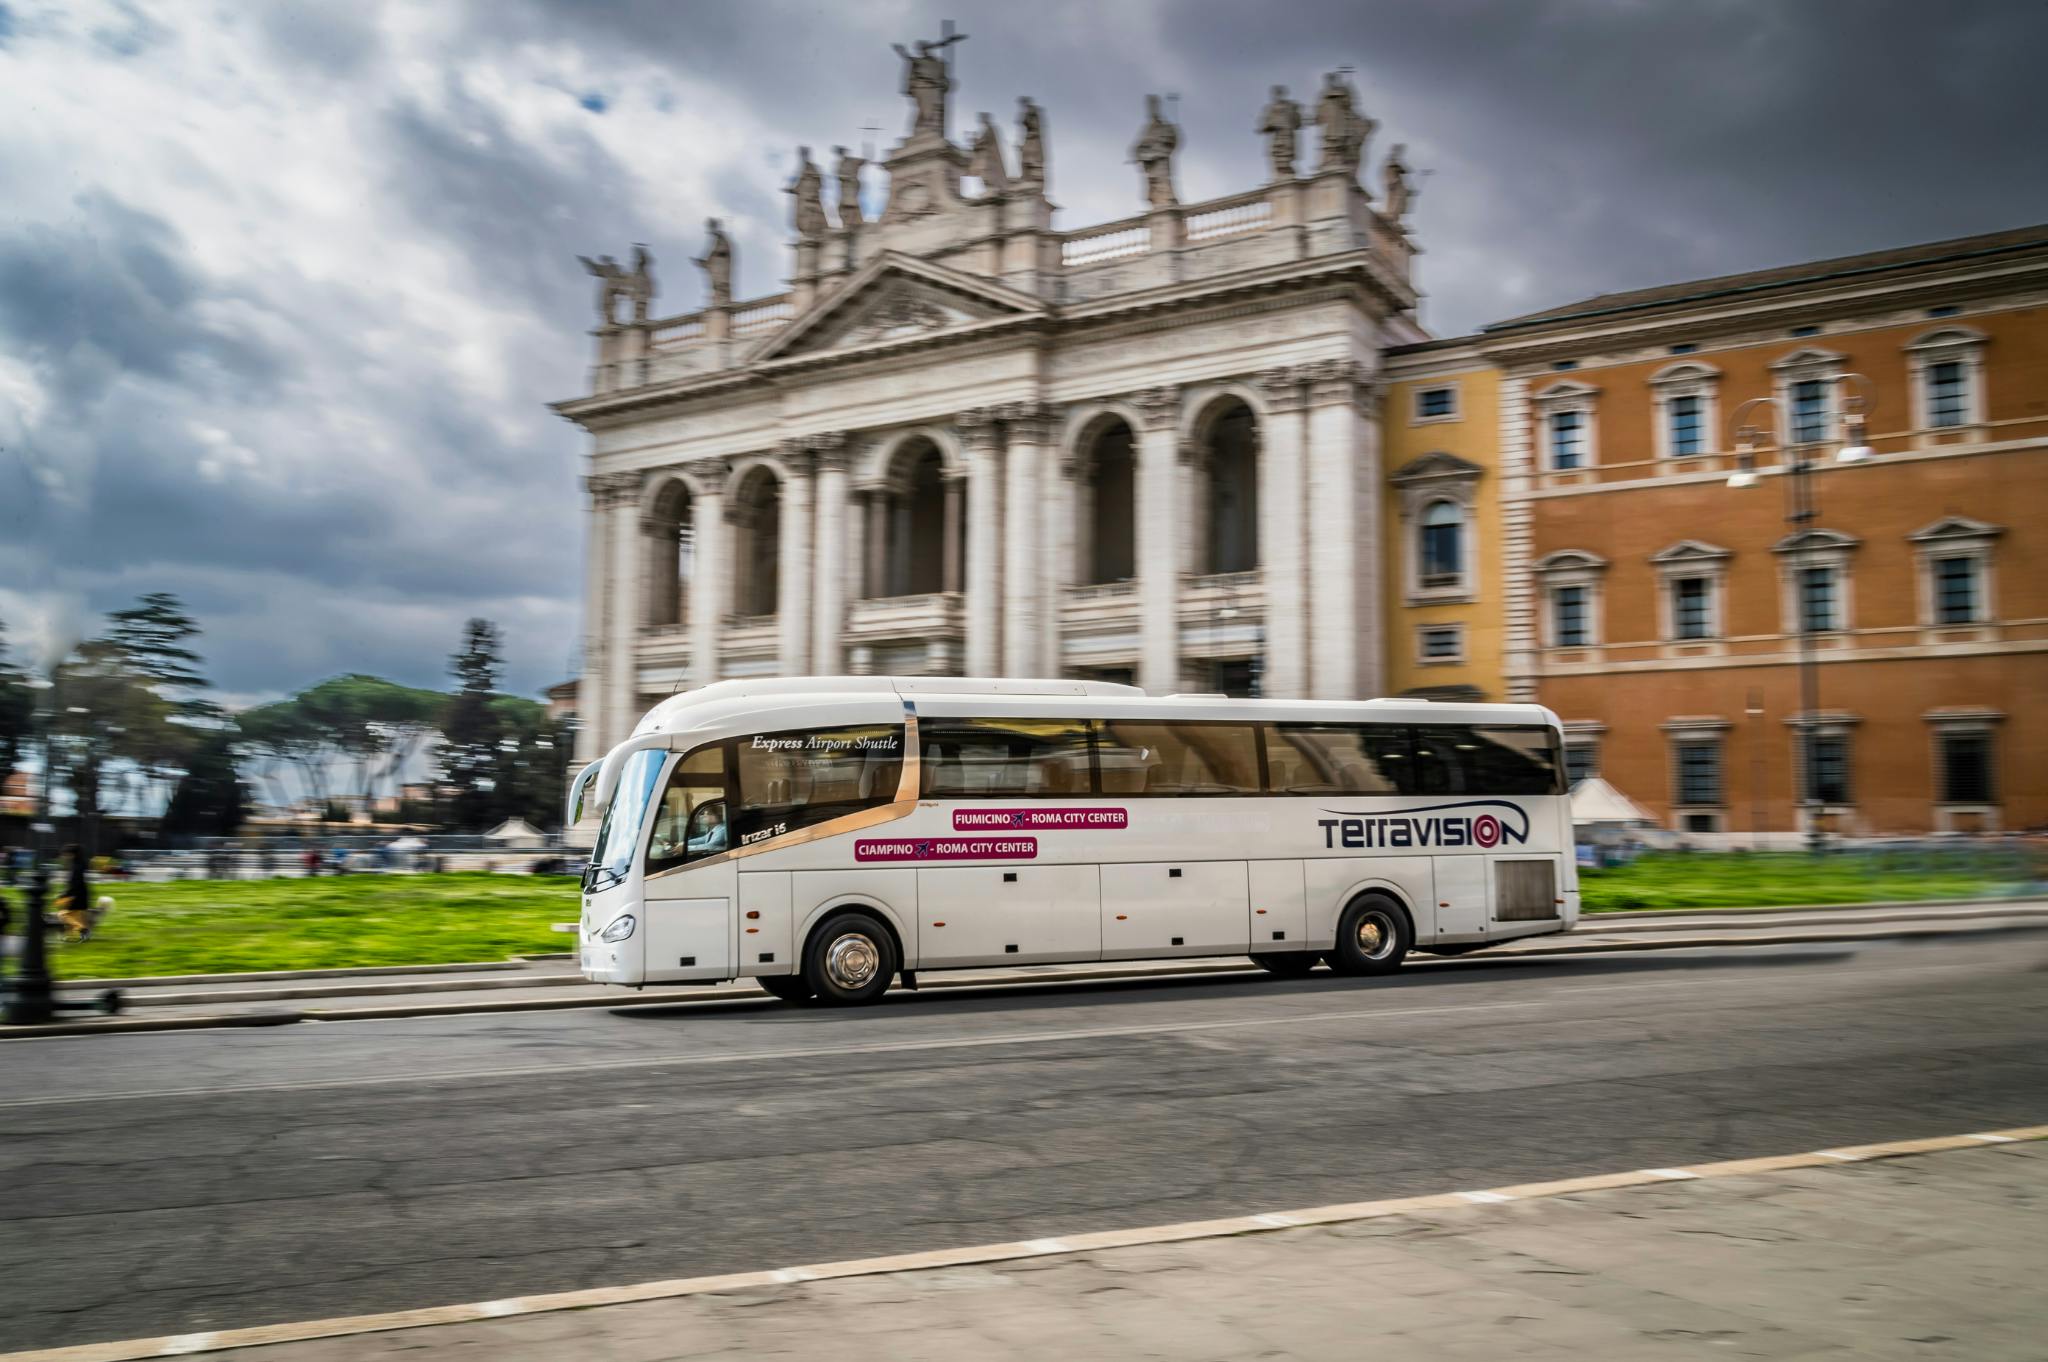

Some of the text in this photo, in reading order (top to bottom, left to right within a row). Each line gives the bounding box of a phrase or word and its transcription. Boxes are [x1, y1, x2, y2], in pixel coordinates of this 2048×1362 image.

[751, 735, 898, 752] Express Airport Shuttle
[955, 813, 1011, 825] FIUMICINO
[1031, 813, 1063, 824] ROMA
[1063, 813, 1086, 823] CITY
[1087, 812, 1125, 823] CENTER
[774, 822, 787, 835] i6
[858, 844, 914, 856] CIAMPINO
[936, 843, 969, 854] ROMA
[970, 842, 993, 853] CITY
[995, 842, 1034, 853] CENTER
